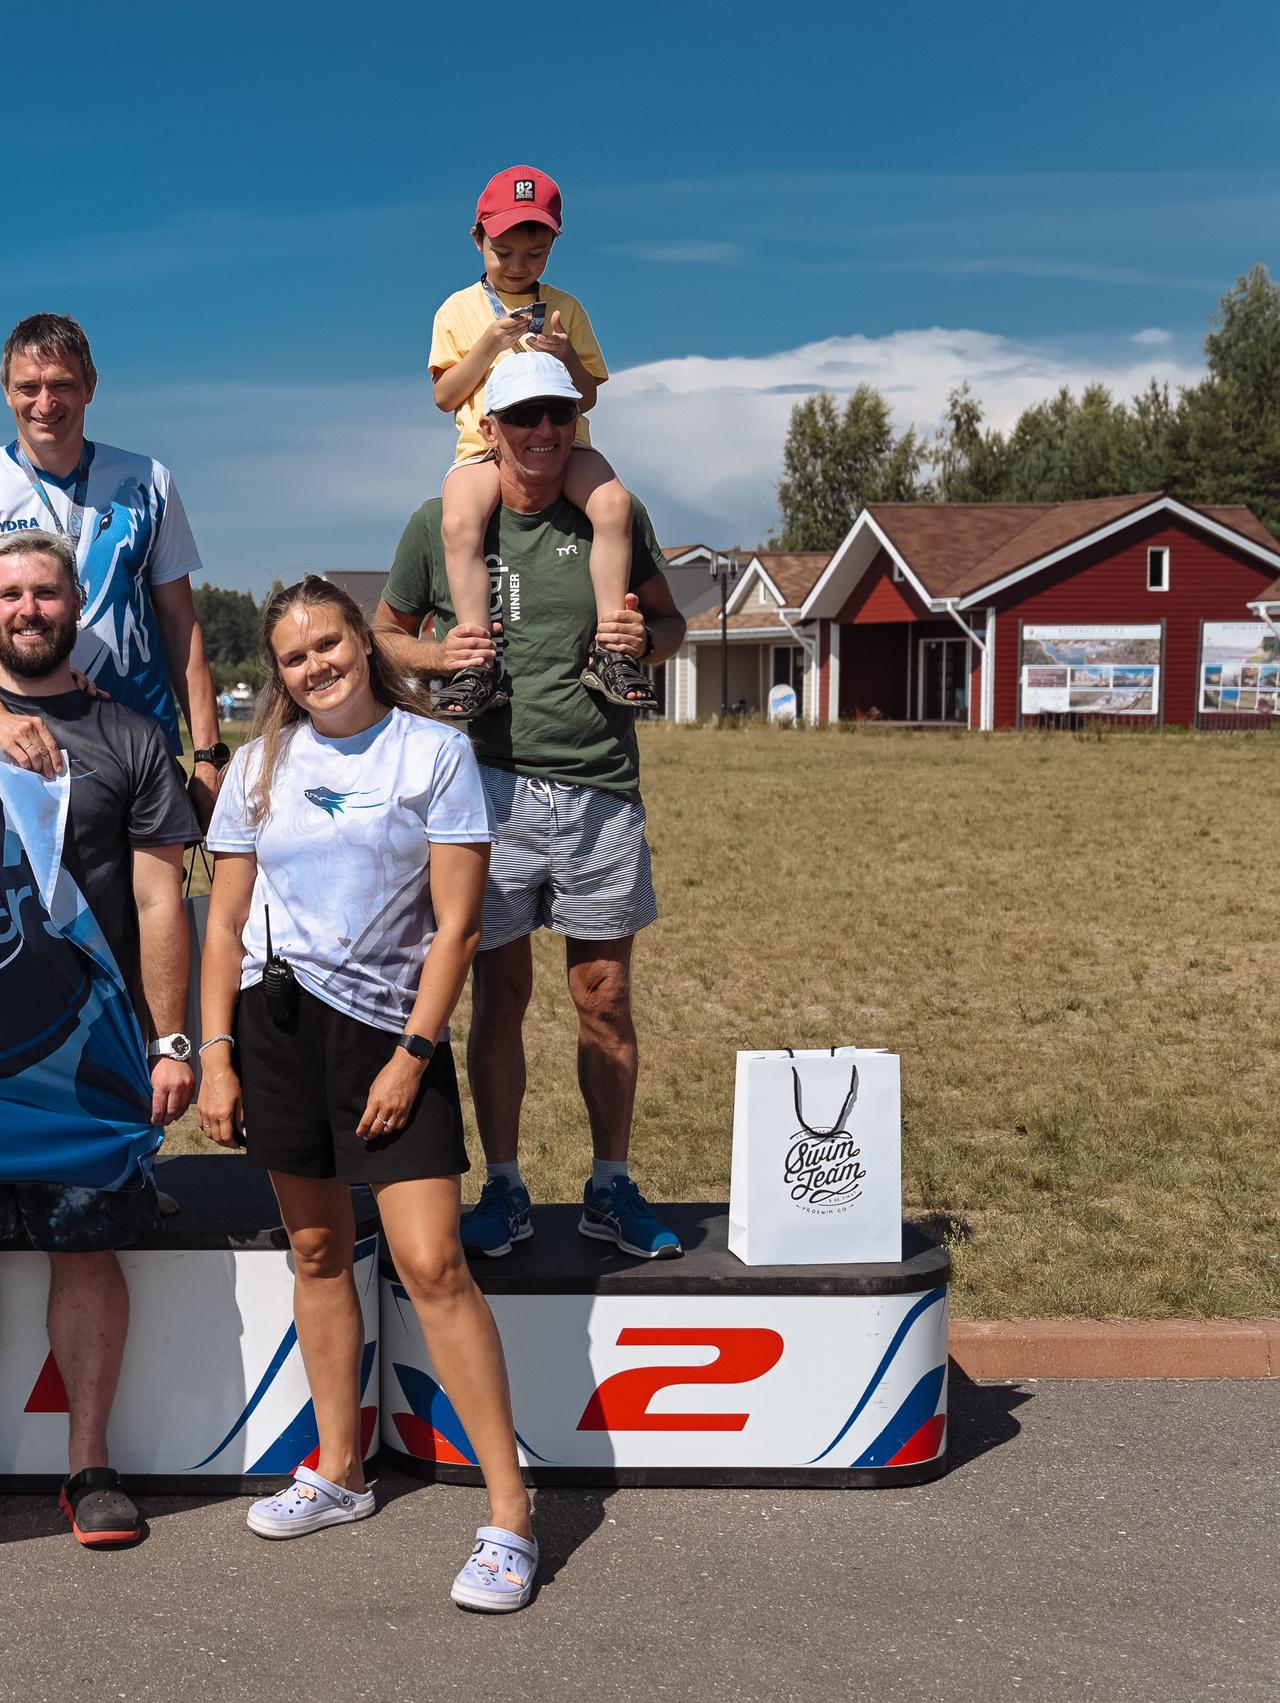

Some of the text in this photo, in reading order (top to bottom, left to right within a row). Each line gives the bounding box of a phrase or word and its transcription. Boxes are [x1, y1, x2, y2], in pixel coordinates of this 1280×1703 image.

[516, 181, 533, 194] 82
[556, 544, 579, 557] TYR
[509, 573, 521, 622] WINNER
[785, 1138, 861, 1175] Swim
[791, 1162, 867, 1200] Team
[802, 1206, 834, 1215] PROSWIM
[576, 1327, 785, 1432] 2
